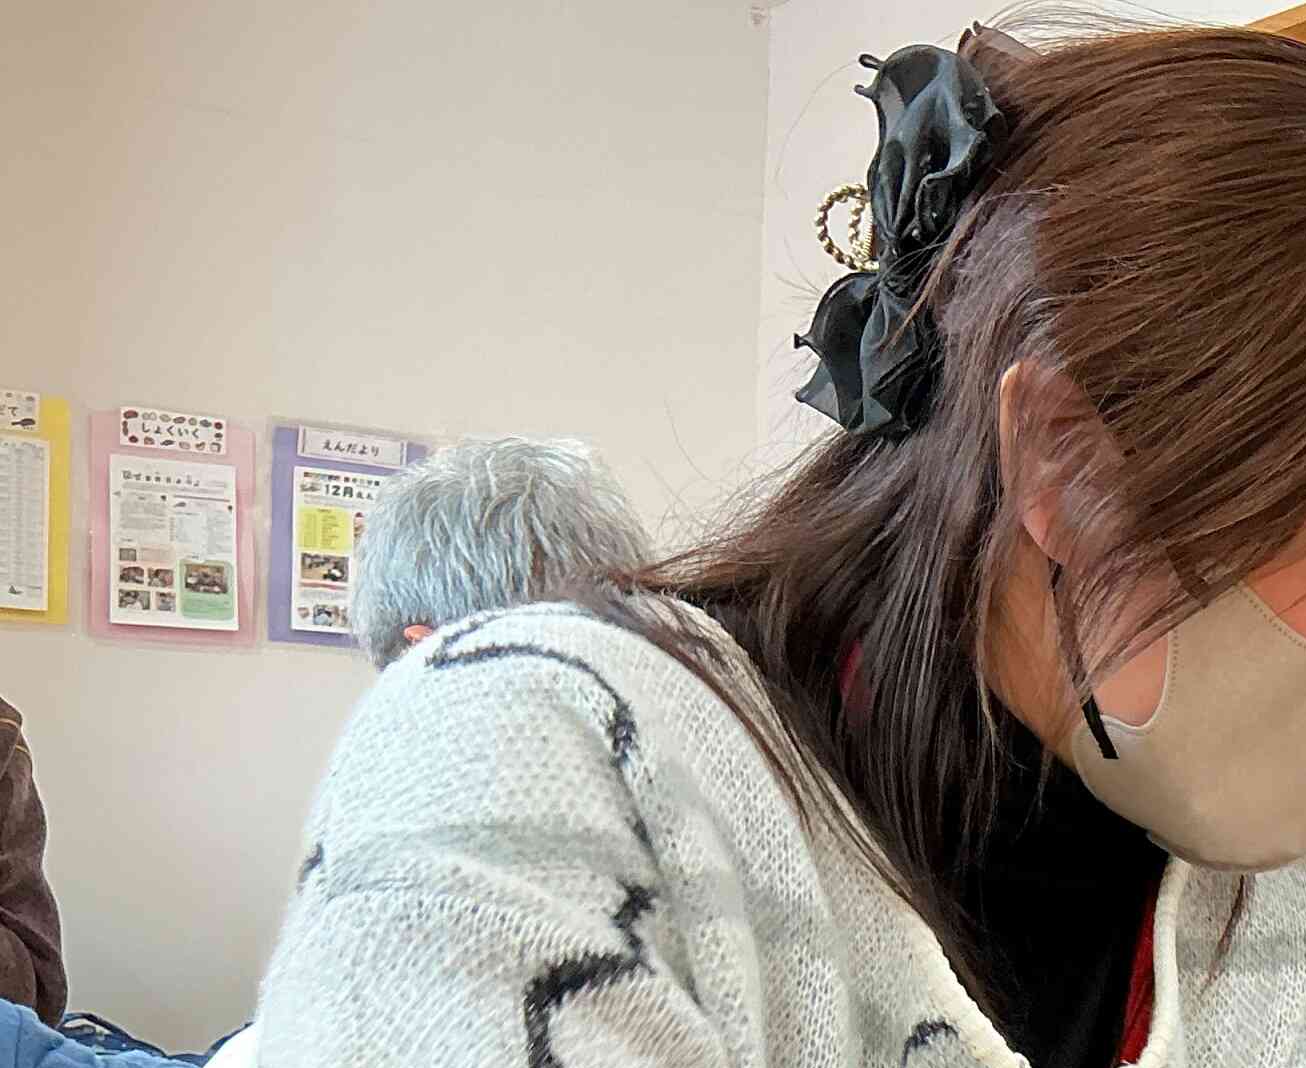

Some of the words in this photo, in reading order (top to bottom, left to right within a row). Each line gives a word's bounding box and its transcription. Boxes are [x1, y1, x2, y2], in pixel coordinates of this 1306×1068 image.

[142, 422, 200, 439] しょくいく
[323, 440, 380, 456] えんだより
